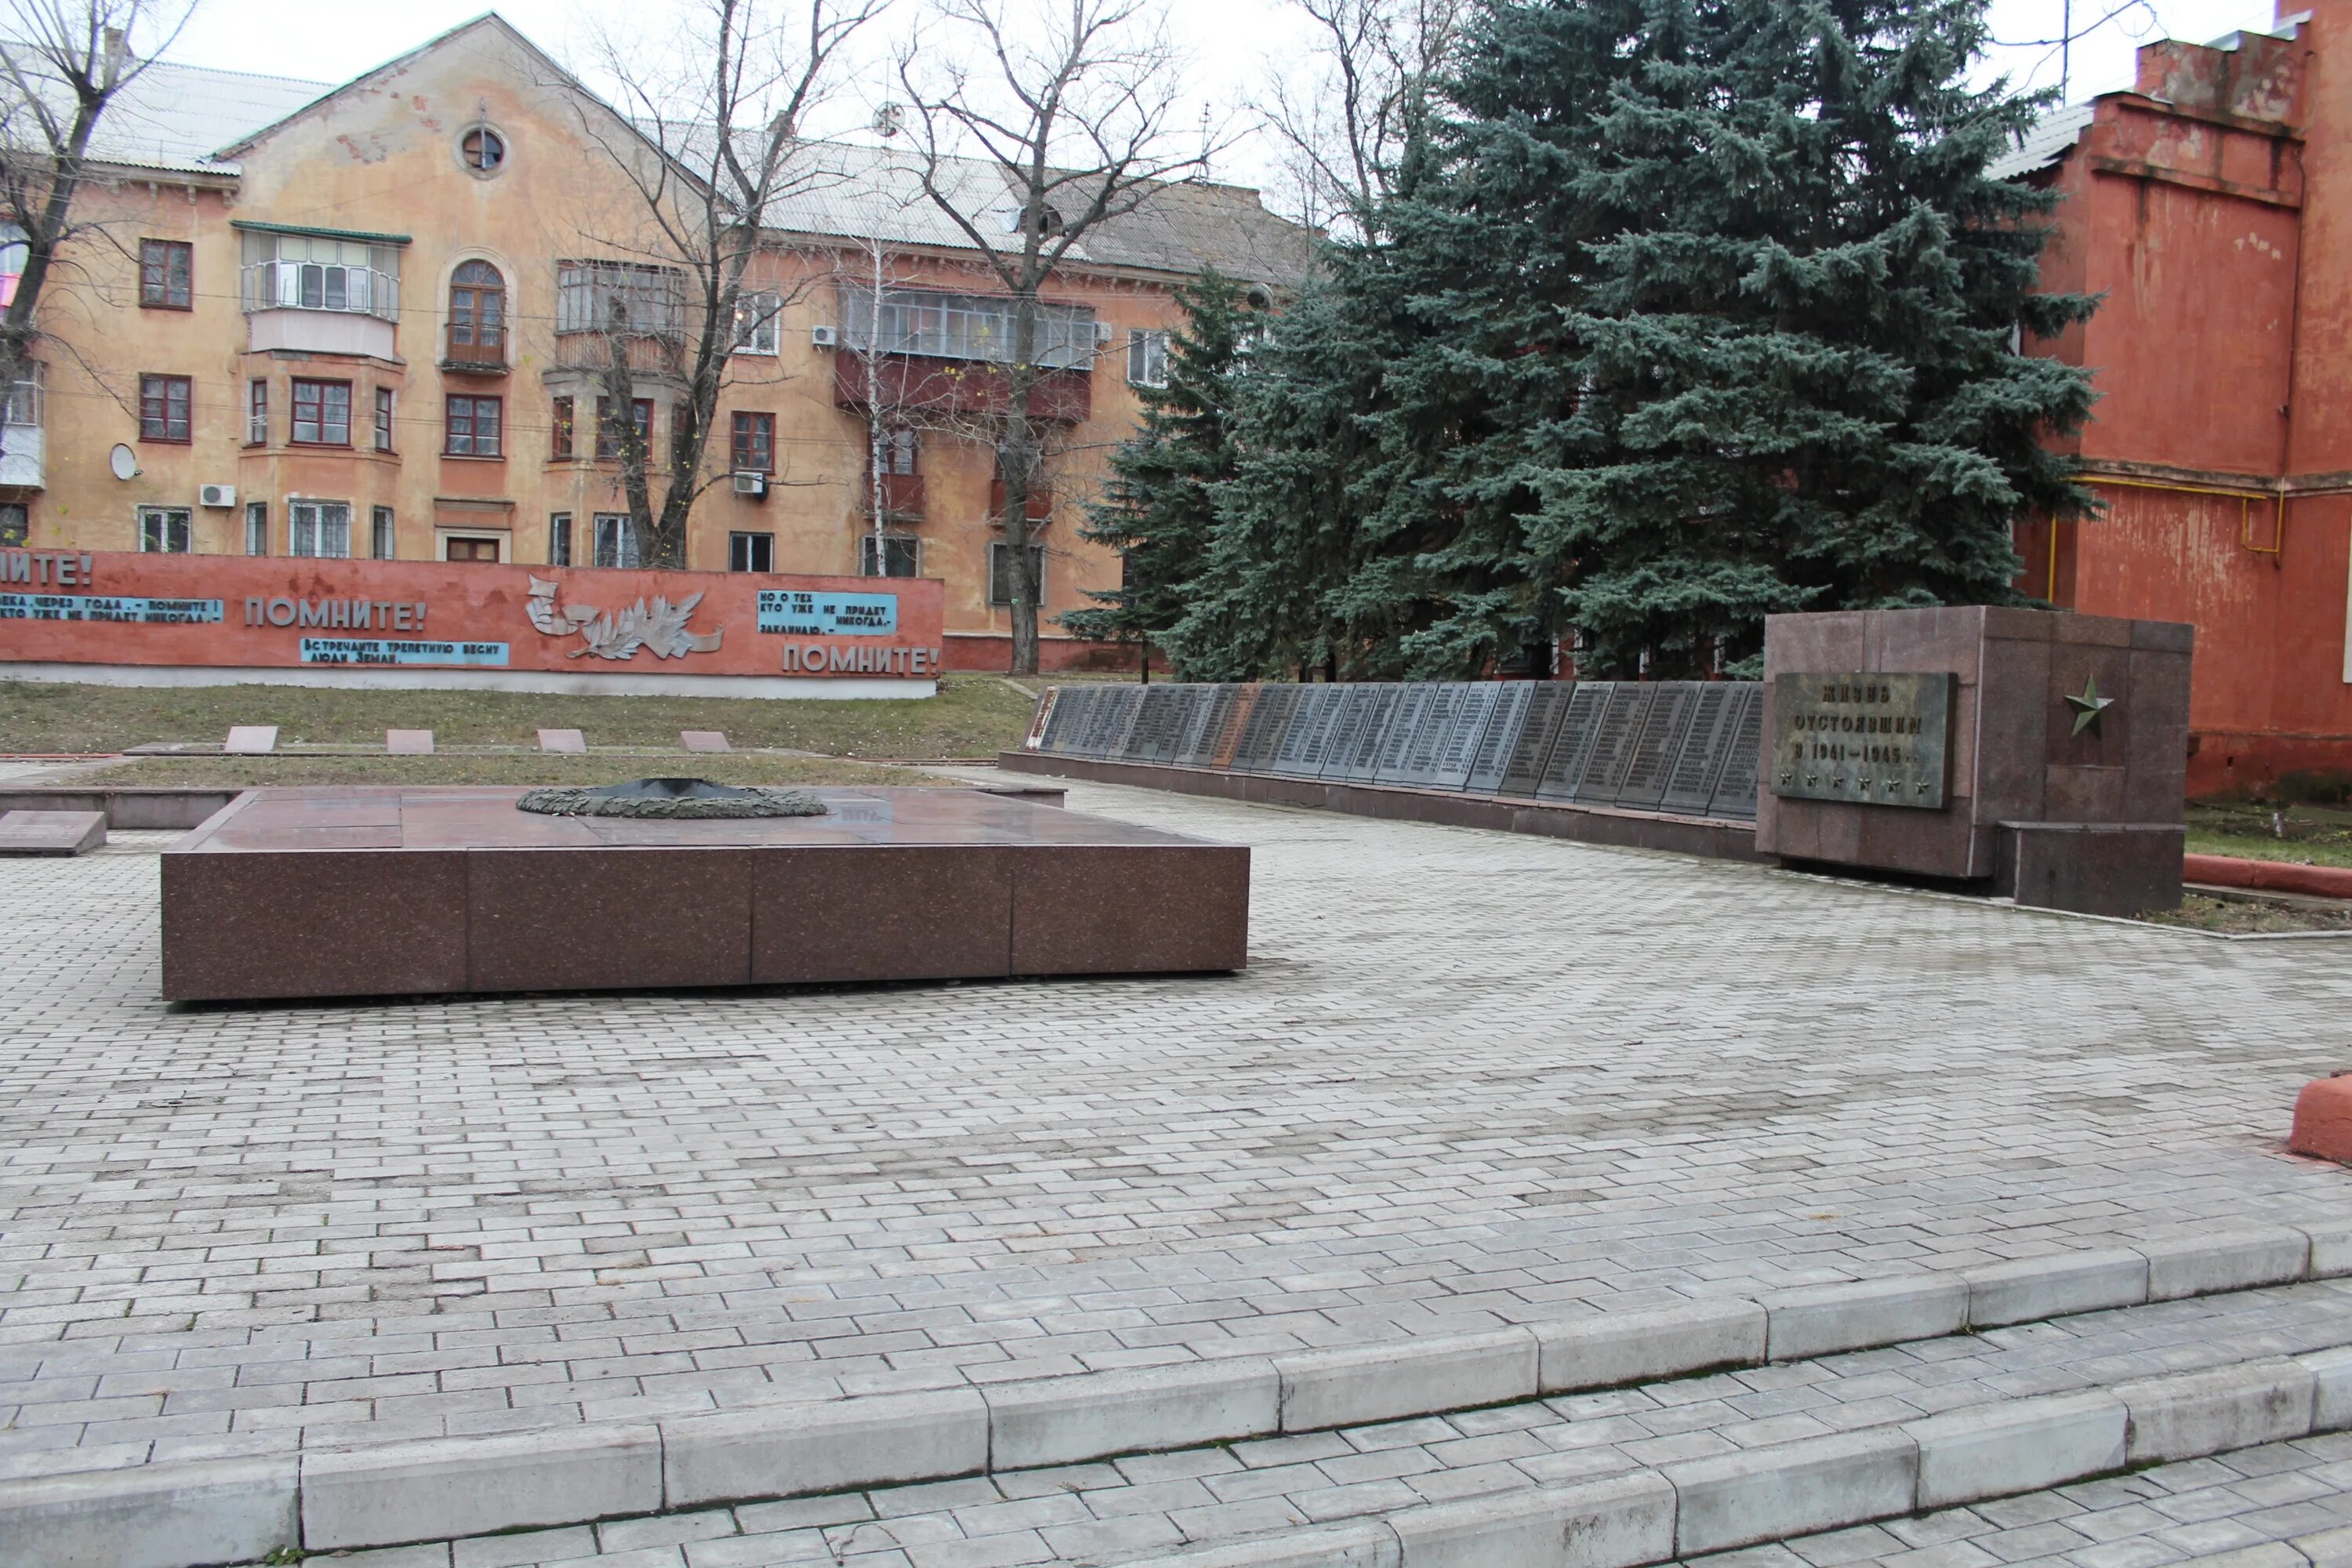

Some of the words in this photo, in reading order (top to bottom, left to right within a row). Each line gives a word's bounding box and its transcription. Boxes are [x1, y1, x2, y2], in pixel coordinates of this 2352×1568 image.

[760, 593, 775, 601] НО
[780, 593, 789, 602] О
[793, 593, 812, 603] ТЕХ
[0, 608, 26, 619] КТО
[33, 608, 60, 619] УЖЕ
[67, 610, 82, 620] НЕ
[245, 597, 426, 631] ПОМНИТЕ!
[760, 603, 782, 612] КТО
[792, 604, 814, 614] УЖЕ
[823, 604, 836, 615] НЕ
[845, 605, 887, 615] ПРИДЕТ
[783, 644, 939, 675] ПОМНИТЕ!
[1822, 685, 1889, 702] ЖИЗНЬ
[1795, 715, 1922, 734] ОТСТОЯВШИМ
